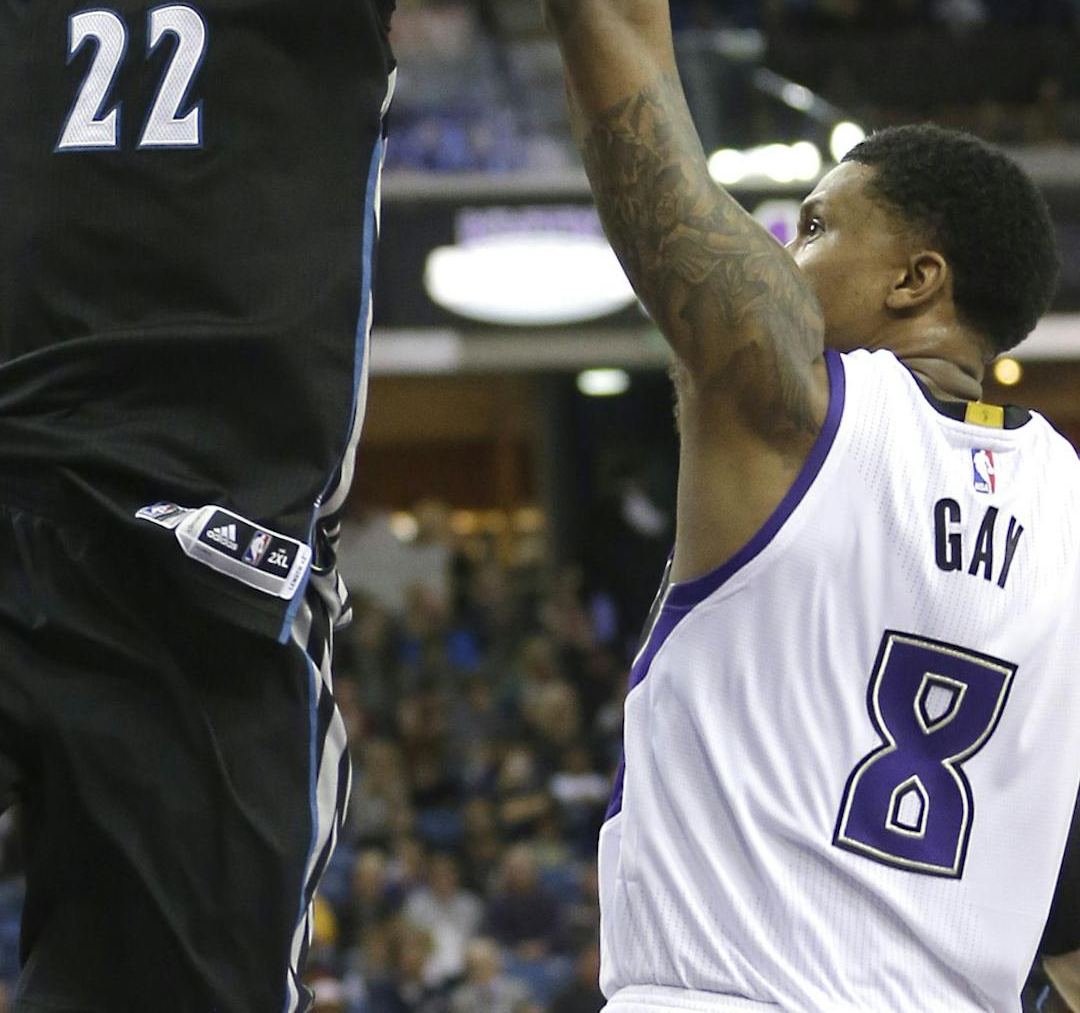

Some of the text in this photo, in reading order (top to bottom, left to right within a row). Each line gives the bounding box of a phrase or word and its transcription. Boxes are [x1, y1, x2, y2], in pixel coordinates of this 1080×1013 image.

[53, 2, 208, 153] 22
[206, 529, 239, 551] adidas
[267, 551, 288, 569] 2XL
[933, 498, 1024, 589] GAY
[832, 629, 1018, 880] 8
